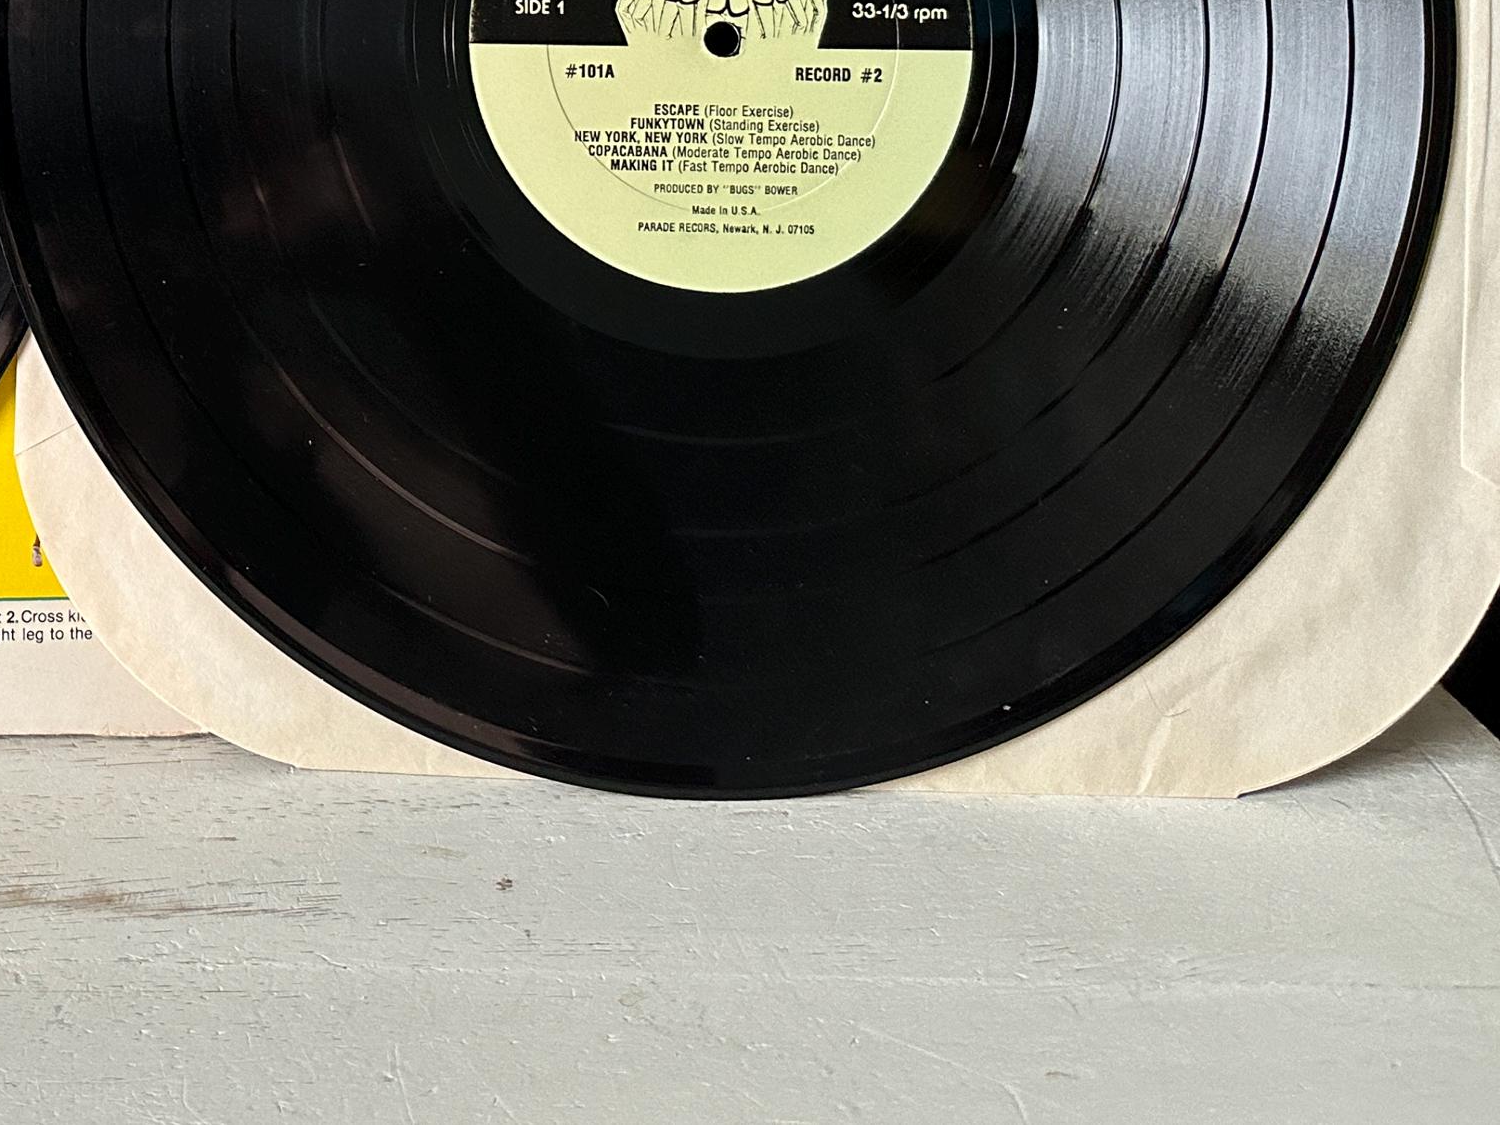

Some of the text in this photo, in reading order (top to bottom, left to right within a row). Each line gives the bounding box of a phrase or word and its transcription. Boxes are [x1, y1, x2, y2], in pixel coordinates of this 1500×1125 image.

[514, 0, 565, 15] SIDE 1
[852, 2, 948, 23] 33-1/3 rpm
[565, 64, 615, 79] #101A
[795, 67, 882, 83] RECORD #2
[654, 104, 794, 118] ESCAPE (Floor Exercise)
[631, 118, 819, 132] FUNKYTOWN (Standing Exercise)
[575, 131, 875, 148] NEW YORK, NEW YORK (Slow Tempo Aerobic Dance)
[589, 145, 861, 162] COPACABANA (Moderate Tempo Aerobic Dance)
[611, 159, 839, 175] MAKING IT (Fast Tempo Aerobic Dance)
[654, 184, 704, 194] PRODUCED
[707, 185, 719, 194] BY
[765, 186, 797, 195] BOWER
[692, 206, 716, 215] Made
[731, 206, 761, 216] U.S.A.
[638, 222, 815, 234] PARADE RECORS, Newark, N. J. 07105
[23, 628, 44, 643] leg
[51, 628, 64, 640] to
[71, 627, 92, 640] the
